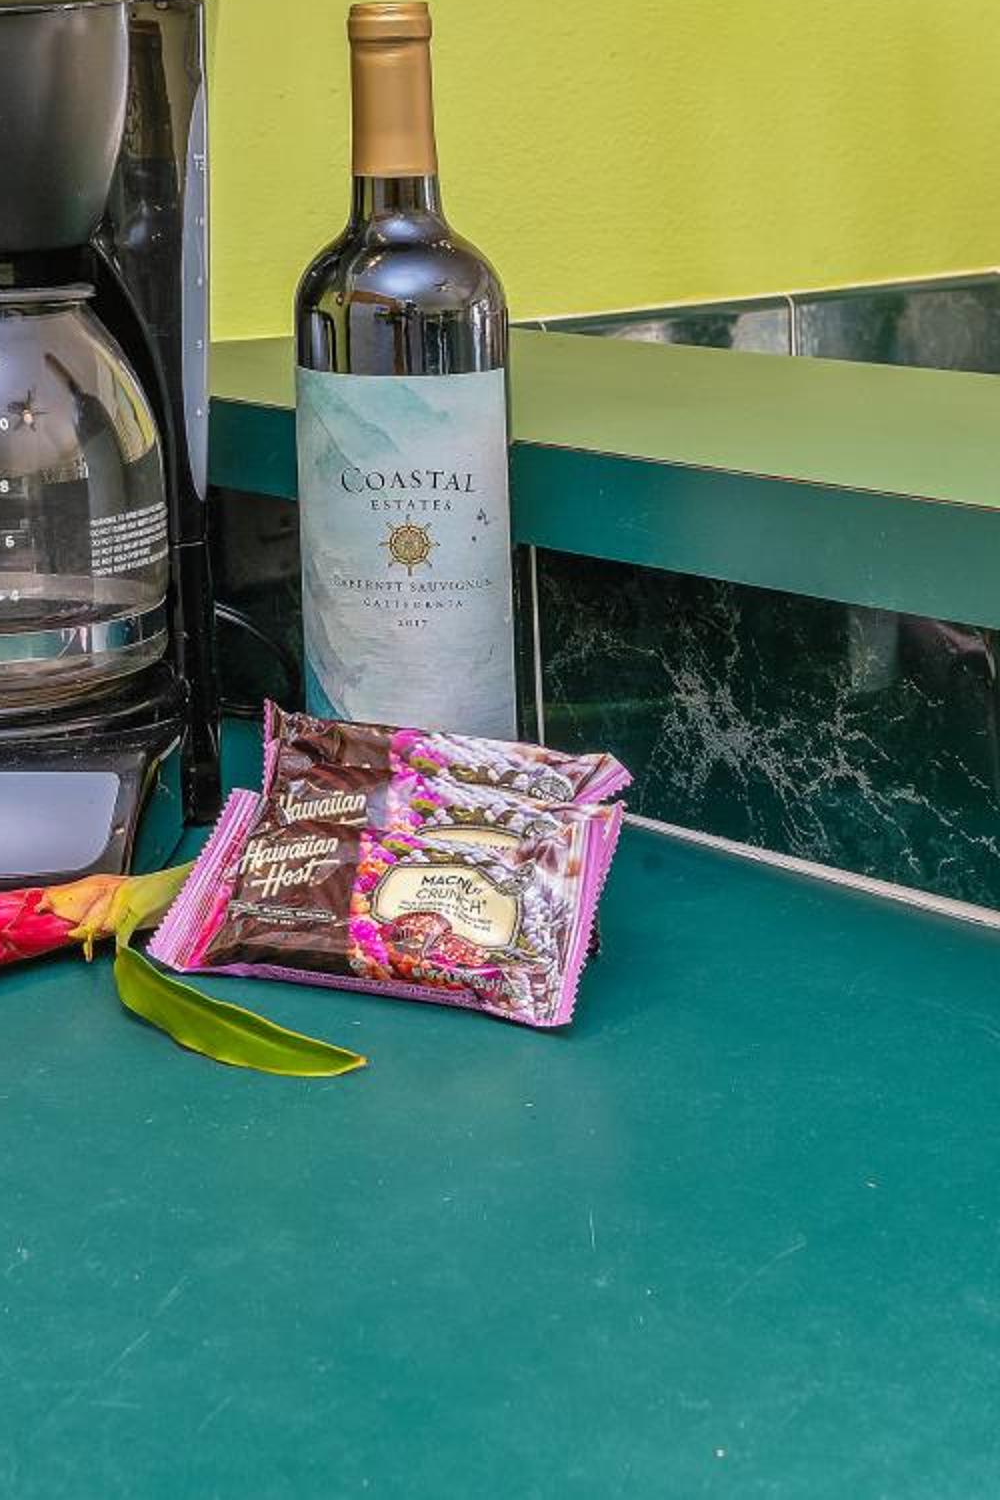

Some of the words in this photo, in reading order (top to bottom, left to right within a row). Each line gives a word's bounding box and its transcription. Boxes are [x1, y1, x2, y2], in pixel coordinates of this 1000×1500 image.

[0, 480, 9, 493] 8
[341, 467, 476, 493] COASTAL
[371, 499, 453, 511] ESTATES
[5, 535, 15, 548] 6
[240, 835, 339, 875] Hawaiian
